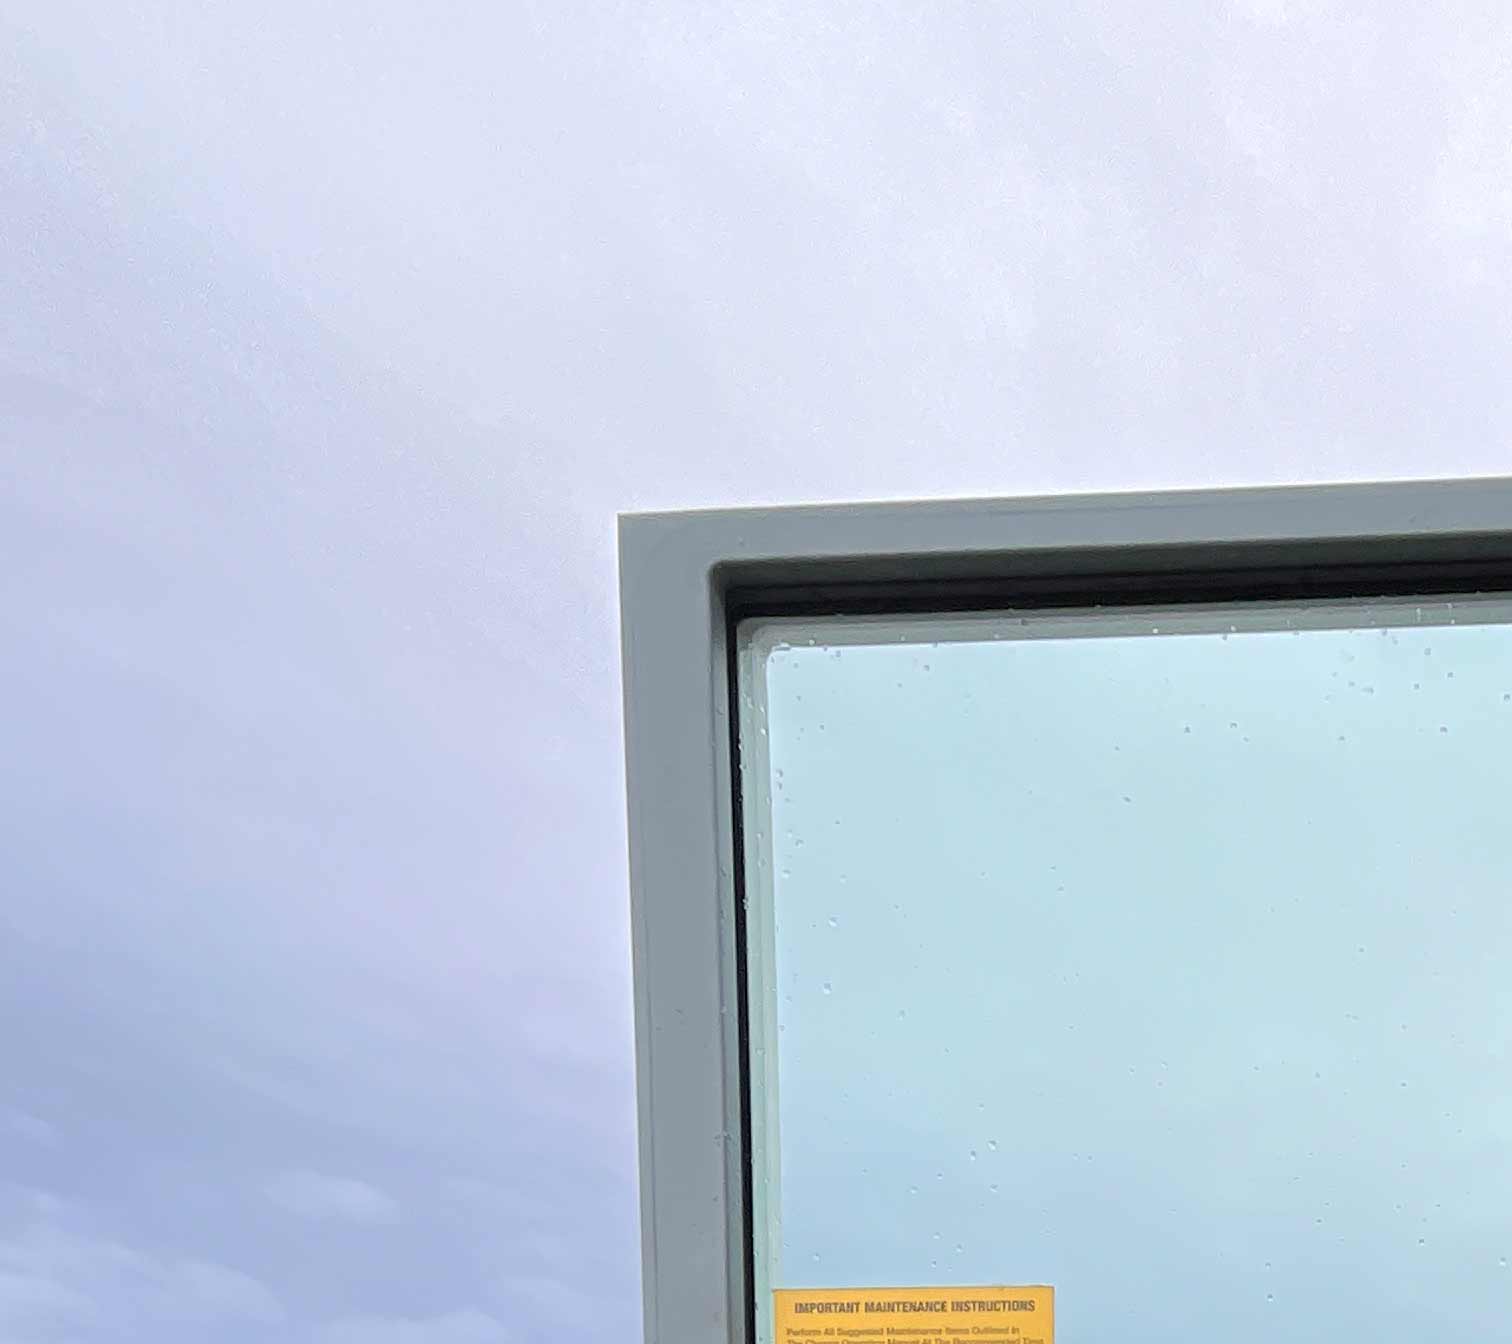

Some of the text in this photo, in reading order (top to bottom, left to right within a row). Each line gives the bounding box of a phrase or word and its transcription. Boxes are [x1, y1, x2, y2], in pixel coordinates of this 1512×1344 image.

[794, 1300, 1036, 1313] IMPORTANT MAINTENANCE INSTRUCTIONS
